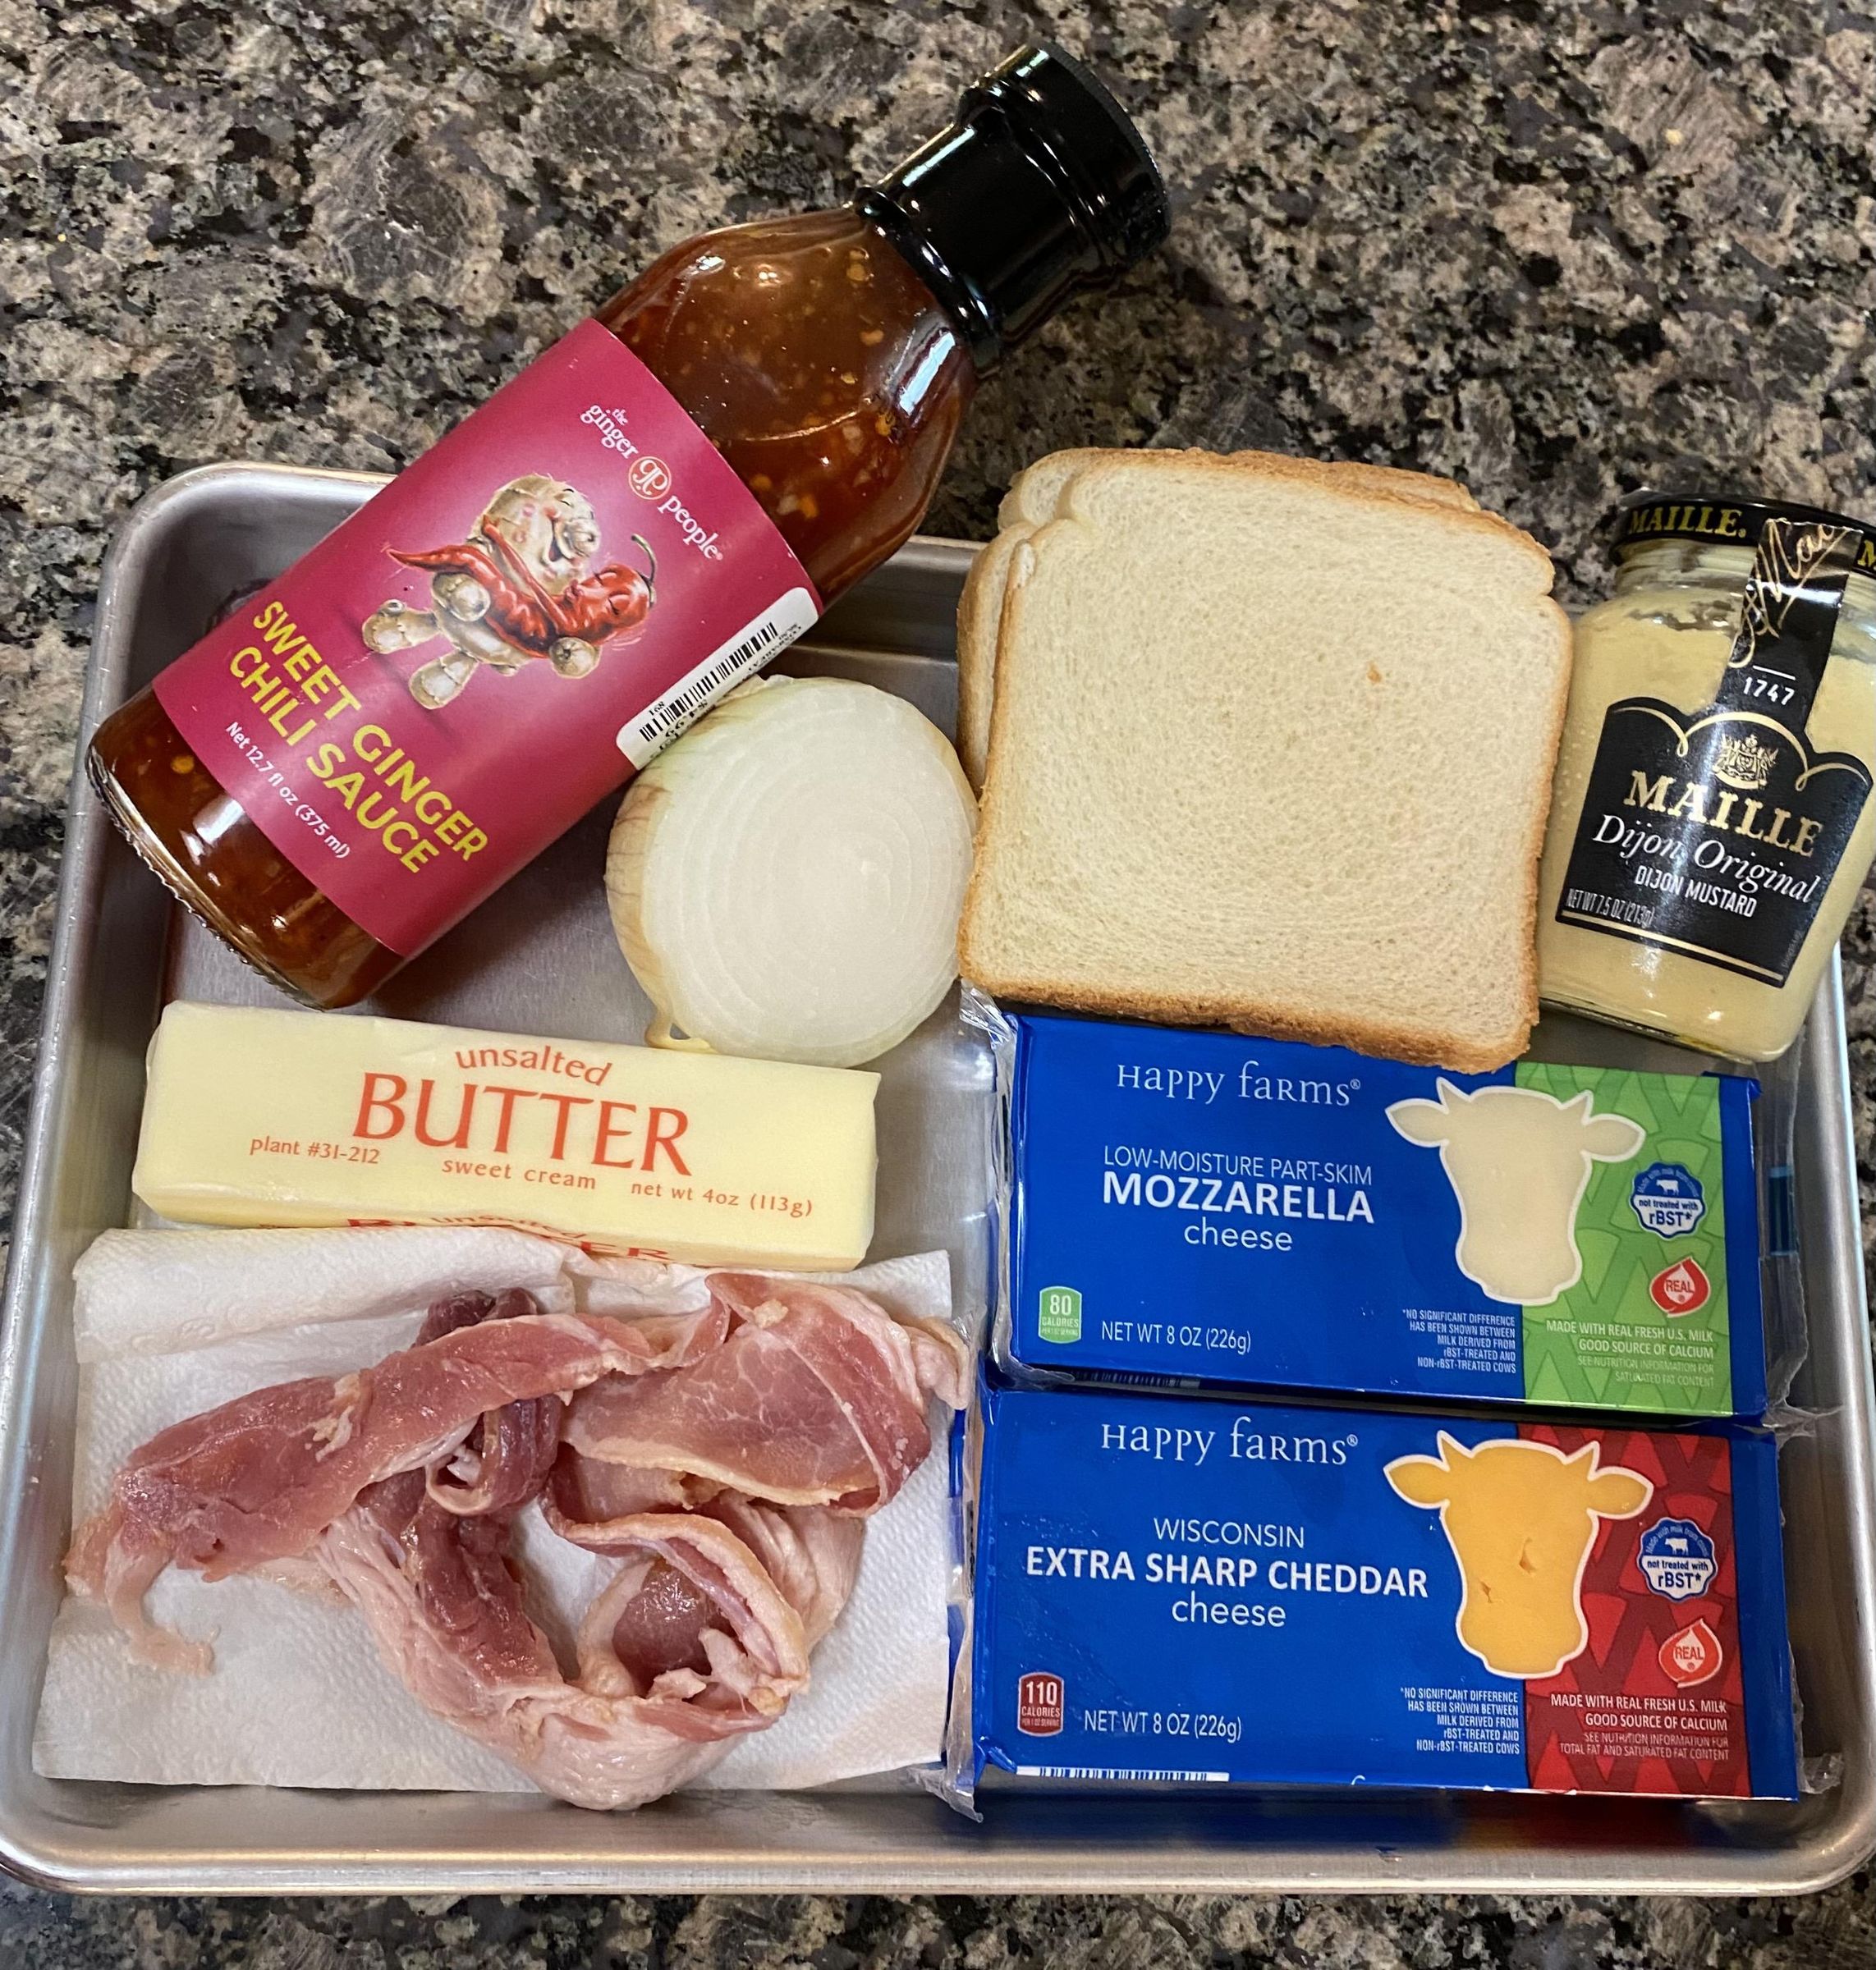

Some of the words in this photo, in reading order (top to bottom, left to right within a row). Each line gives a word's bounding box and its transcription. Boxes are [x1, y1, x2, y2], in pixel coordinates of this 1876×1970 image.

[612, 407, 629, 426] the
[580, 404, 639, 459] ginger
[1743, 676, 1796, 705] 1747
[253, 601, 362, 720] SWEET
[353, 724, 488, 861] GINGER
[230, 647, 317, 746] CHILI
[306, 743, 440, 873] SAUCE
[226, 722, 250, 749] Net
[245, 745, 275, 772] 12.7
[268, 772, 284, 787] fl
[279, 786, 299, 806] oz
[295, 804, 331, 836] (375
[323, 835, 351, 859] ml)
[1622, 770, 1823, 858] MAILLE
[1593, 813, 1687, 859] Dijon
[1694, 839, 1821, 904] Original
[1566, 887, 1585, 909] NET
[1582, 891, 1598, 911] WT
[1596, 895, 1612, 916] 7.5
[1610, 898, 1626, 919] OZ
[1634, 864, 1685, 896] DIJON
[1685, 879, 1758, 918] MUSTARD
[455, 1045, 612, 1086] unsalted
[1117, 1064, 1226, 1105] Happy
[353, 1072, 692, 1176] BUTTER
[249, 1136, 300, 1156] plant
[307, 1141, 380, 1165] #31-212
[442, 1159, 512, 1180] sweet
[524, 1168, 596, 1189] cream
[1104, 1145, 1264, 1177] LOW-MOISTURE
[1271, 1158, 1372, 1186] PART-SKIM
[631, 1182, 662, 1198] net
[671, 1185, 694, 1200] wt
[703, 1189, 739, 1206] 4oz
[750, 1193, 813, 1218] (113g)
[1103, 1171, 1375, 1224] MOZZARELLA
[1639, 1198, 1651, 1207] not
[1184, 1216, 1293, 1251] cheese
[1665, 1279, 1695, 1294] REAL
[1049, 1294, 1072, 1316] 80
[1041, 1316, 1080, 1328] CALORIES
[1410, 1321, 1425, 1331] HAS
[1427, 1322, 1447, 1333] BEEN
[1448, 1323, 1478, 1335] SHOWN
[1479, 1326, 1516, 1338] BETWEEN
[1419, 1309, 1467, 1322] SIGNIFICANT
[1469, 1313, 1516, 1327] DIFFERENCE
[1102, 1320, 1134, 1342] NET
[1137, 1322, 1163, 1344] WT
[1166, 1325, 1176, 1345] 8
[1179, 1326, 1202, 1347] OZ
[1205, 1327, 1251, 1354] (226g)
[1437, 1335, 1456, 1345] MILK
[1458, 1335, 1491, 1348] DERIVED
[1493, 1339, 1516, 1349] FROM
[1546, 1320, 1577, 1334] MADE
[1579, 1322, 1606, 1335] WITH
[1608, 1324, 1632, 1337] REAL
[1635, 1326, 1665, 1339] FRESH
[1667, 1328, 1687, 1340] U.S.
[1689, 1330, 1713, 1343] MILK
[1443, 1347, 1498, 1360] rBST-TREATED
[1499, 1351, 1516, 1362] AND
[1579, 1338, 1610, 1352] GOOD
[1612, 1340, 1652, 1354] SOURCE
[1654, 1343, 1667, 1355] OF
[1669, 1345, 1714, 1359] CALCIUM
[1417, 1356, 1491, 1372] NON-rBST-TREATED
[1493, 1363, 1516, 1374] COWS
[1101, 1423, 1216, 1466] Happy
[1154, 1517, 1305, 1549] WISCONSIN
[1026, 1545, 1135, 1581] EXTRA
[1145, 1552, 1258, 1588] SHARP
[1268, 1560, 1429, 1598] CHEDDAR
[1647, 1560, 1659, 1569] not
[1662, 1560, 1689, 1569] treated
[1691, 1561, 1709, 1571] with
[1172, 1590, 1287, 1627] cheese
[1675, 1647, 1704, 1660] REAL
[1025, 1681, 1057, 1706] 110
[1418, 1688, 1468, 1701] SIGNIFICANT
[1470, 1690, 1518, 1703] DIFFERENCE
[1551, 1693, 1583, 1707] MADE
[1585, 1695, 1613, 1708] WITH
[1616, 1696, 1642, 1710] REAL
[1644, 1697, 1676, 1711] FRESH
[1678, 1699, 1698, 1712] U.S.
[1700, 1700, 1727, 1713] MILK
[1021, 1706, 1061, 1718] CALORIES
[1408, 1701, 1424, 1711] HAS
[1426, 1702, 1447, 1712] BEEN
[1448, 1702, 1479, 1714] SHOWN
[1481, 1703, 1518, 1716] BETWEEN
[1084, 1709, 1117, 1731] NET
[1121, 1711, 1149, 1733] WT
[1153, 1712, 1162, 1734] 8
[1167, 1713, 1190, 1735] OZ
[1194, 1714, 1241, 1743] (226g)
[1437, 1714, 1457, 1725] MILK
[1459, 1716, 1493, 1727] DERIVED
[1496, 1716, 1519, 1729] FROM
[1585, 1712, 1617, 1727] GOOD
[1620, 1714, 1661, 1729] SOURCE
[1663, 1716, 1677, 1729] OF
[1681, 1716, 1727, 1731] CALCIUM
[1416, 1739, 1493, 1753] NON-rBST-TREATED
[1496, 1743, 1520, 1754] COWS
[1443, 1728, 1500, 1741] rBST-TREATED
[1502, 1730, 1519, 1742] AND
[1584, 1732, 1599, 1743] SEE
[1601, 1732, 1649, 1744] NUTRITION
[1650, 1734, 1710, 1747] INFORMATION
[1712, 1737, 1728, 1748] FOR
[1560, 1743, 1585, 1755] TOTAL
[1587, 1743, 1601, 1755] FAT
[1603, 1744, 1622, 1757] AND
[1624, 1746, 1672, 1758] SATURATED
[1673, 1748, 1687, 1760] FAT
[1690, 1748, 1729, 1761] CONTENT
